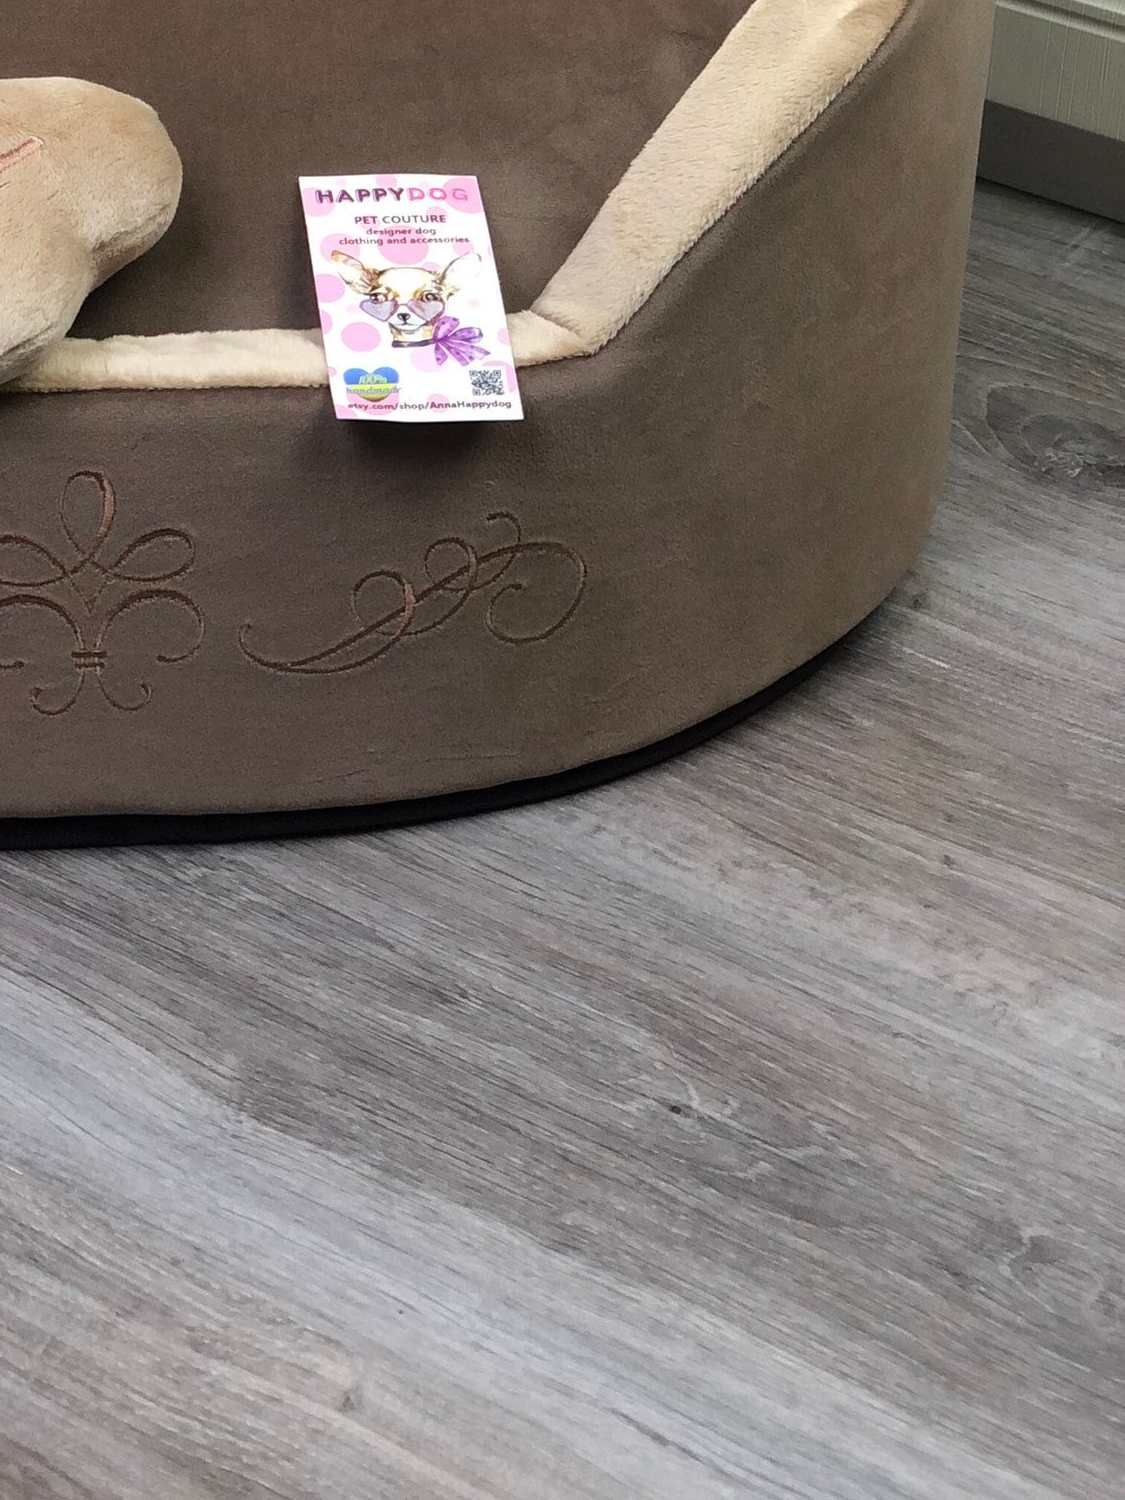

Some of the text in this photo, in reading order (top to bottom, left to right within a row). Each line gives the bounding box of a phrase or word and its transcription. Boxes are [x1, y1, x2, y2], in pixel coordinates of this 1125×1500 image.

[354, 214, 447, 225] PET COUTURE
[366, 227, 437, 237] designer dog
[338, 237, 384, 246] clothing
[410, 235, 470, 244] accessories
[347, 400, 512, 411] etsy.com/shop/AnnaHappydog
